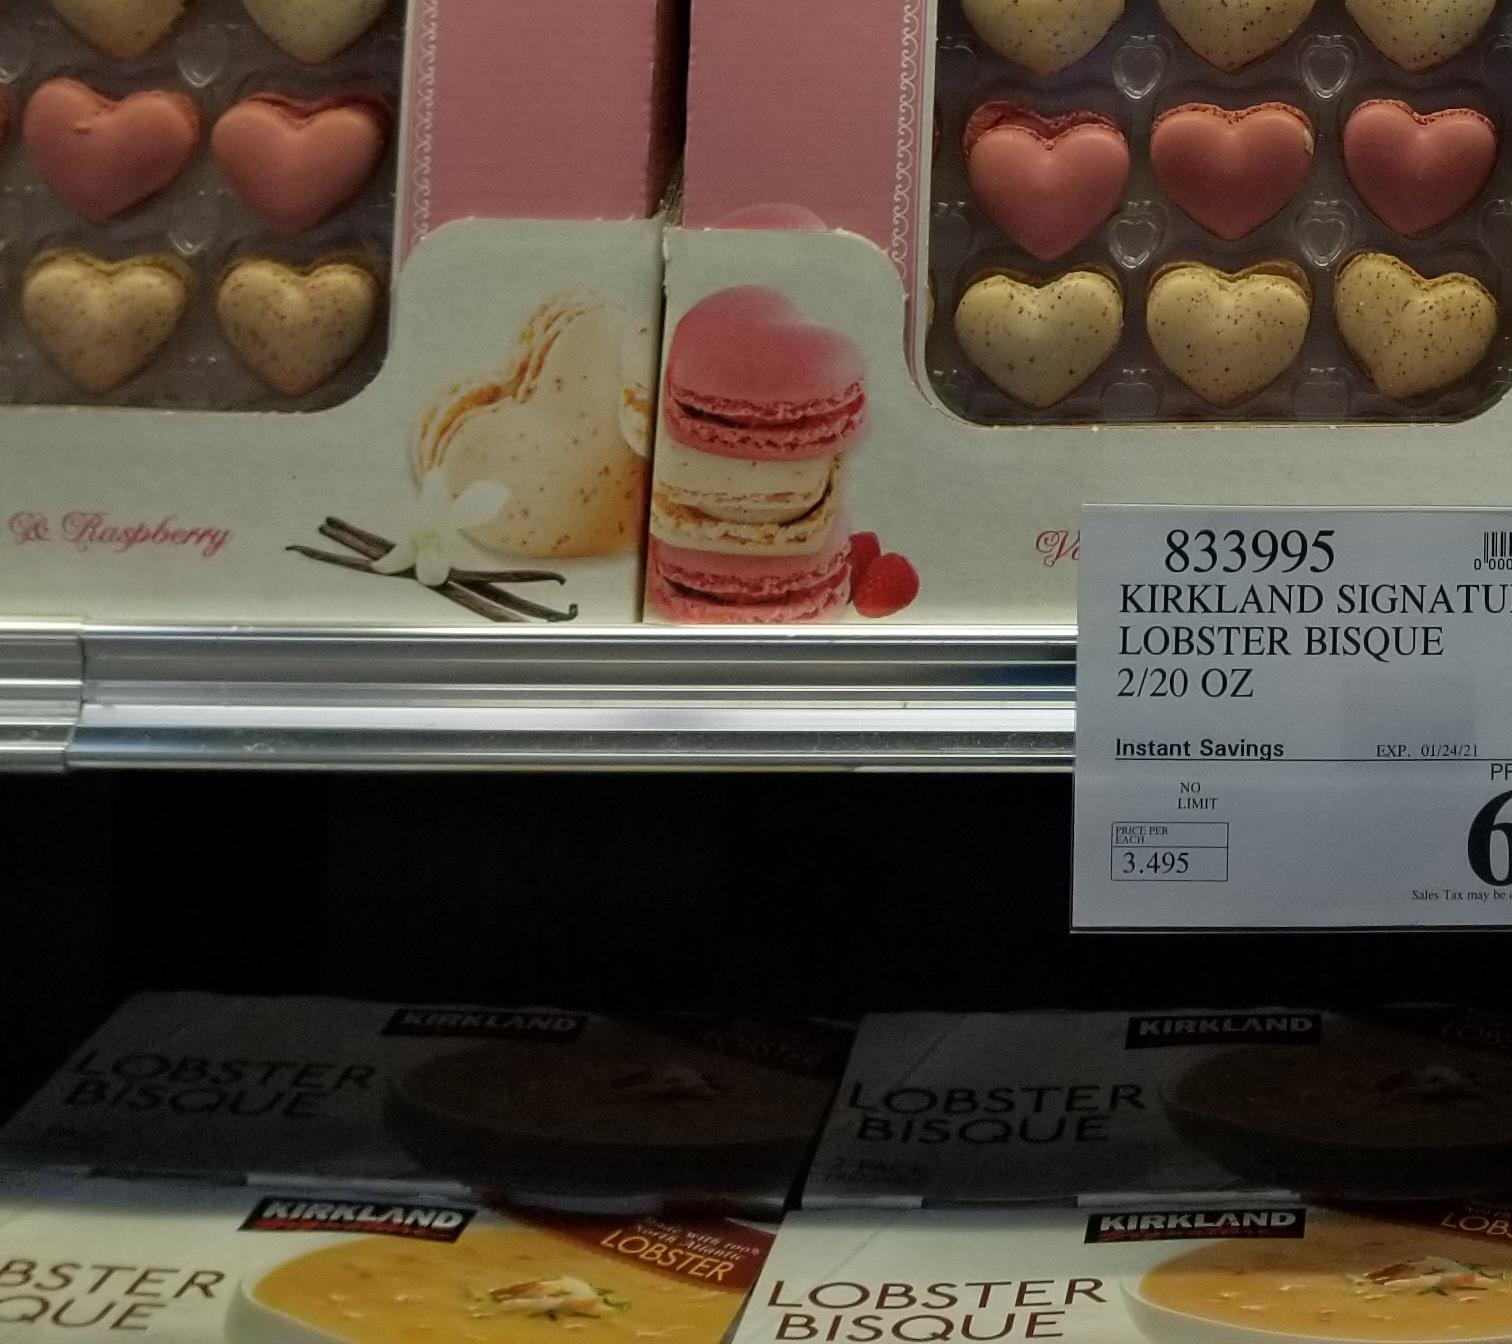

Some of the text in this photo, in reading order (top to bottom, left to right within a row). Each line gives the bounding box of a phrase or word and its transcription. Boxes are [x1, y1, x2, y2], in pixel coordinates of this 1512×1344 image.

[9, 511, 230, 558] & Raspberry
[1164, 528, 1336, 574] 833995
[1118, 583, 1325, 614] KIRKLAND
[1117, 625, 1445, 662] LOBSTER BISQUE
[1116, 667, 1254, 699] 2/20 OZ
[1115, 737, 1285, 761] Instant Savings
[1375, 743, 1479, 759] EXP. 01/24/21
[1179, 781, 1201, 793] NO
[1177, 797, 1218, 810] LIMIT
[1122, 851, 1189, 874] 3.495
[1411, 889, 1440, 901] Sales
[1443, 889, 1463, 901] Tax
[1467, 891, 1489, 903] may
[1493, 889, 1507, 901] be
[1138, 1016, 1313, 1036] KIRKLAND
[74, 1050, 377, 1090] LOBSTER
[849, 1082, 1146, 1113] LOBSTER
[857, 1115, 1112, 1144] BISQUE
[264, 1199, 464, 1231] KIRKLAND
[1099, 1210, 1298, 1233] KIRKLAND
[600, 1228, 735, 1282] LOBSTER
[767, 1278, 1109, 1310] LOBSTER
[774, 1310, 1066, 1343] BISQUE
